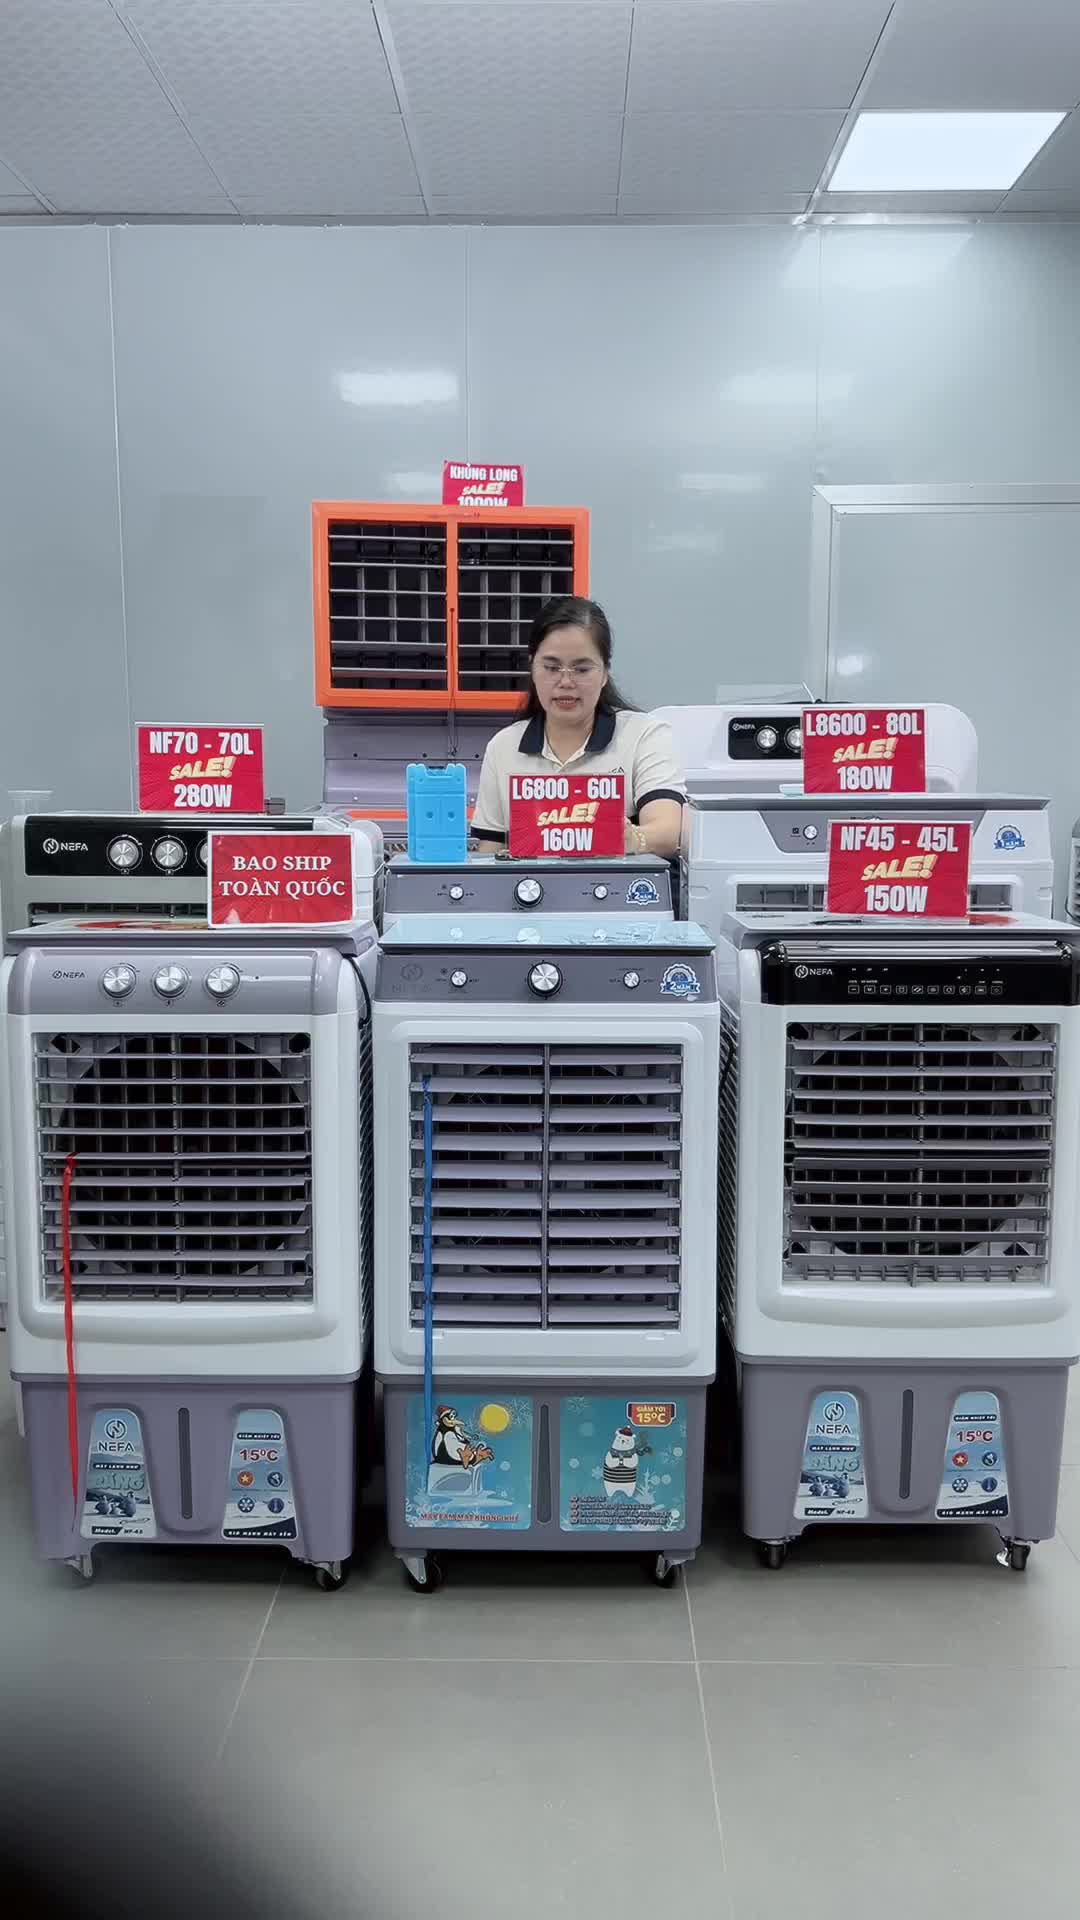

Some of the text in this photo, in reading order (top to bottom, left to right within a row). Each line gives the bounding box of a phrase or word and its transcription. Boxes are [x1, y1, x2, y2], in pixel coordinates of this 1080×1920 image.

[489, 467, 518, 482] LONG
[461, 482, 507, 497] SALE!
[806, 713, 866, 736] L8600
[886, 712, 922, 736] 80L
[149, 731, 199, 756] NF70
[218, 732, 254, 756] 70L
[832, 737, 898, 763] SALE!
[169, 756, 236, 781] SALE!
[836, 766, 893, 790] 180W
[173, 783, 233, 808] 280W
[512, 778, 569, 801] L6800
[586, 778, 621, 801] 60L
[536, 801, 599, 826] SALE!
[60, 842, 89, 852] NEFA
[541, 827, 594, 853] 160W
[840, 826, 895, 851] NF45
[917, 826, 958, 853] 45L
[233, 854, 333, 872] BAO SHIP
[860, 854, 939, 881] SALE!
[219, 876, 347, 899] TOÀN QUỐC
[863, 885, 928, 913] 150W
[63, 971, 86, 979] NEFA
[809, 967, 834, 976] NEFA
[816, 1424, 851, 1435] NEFA
[98, 1441, 135, 1452] NEFA
